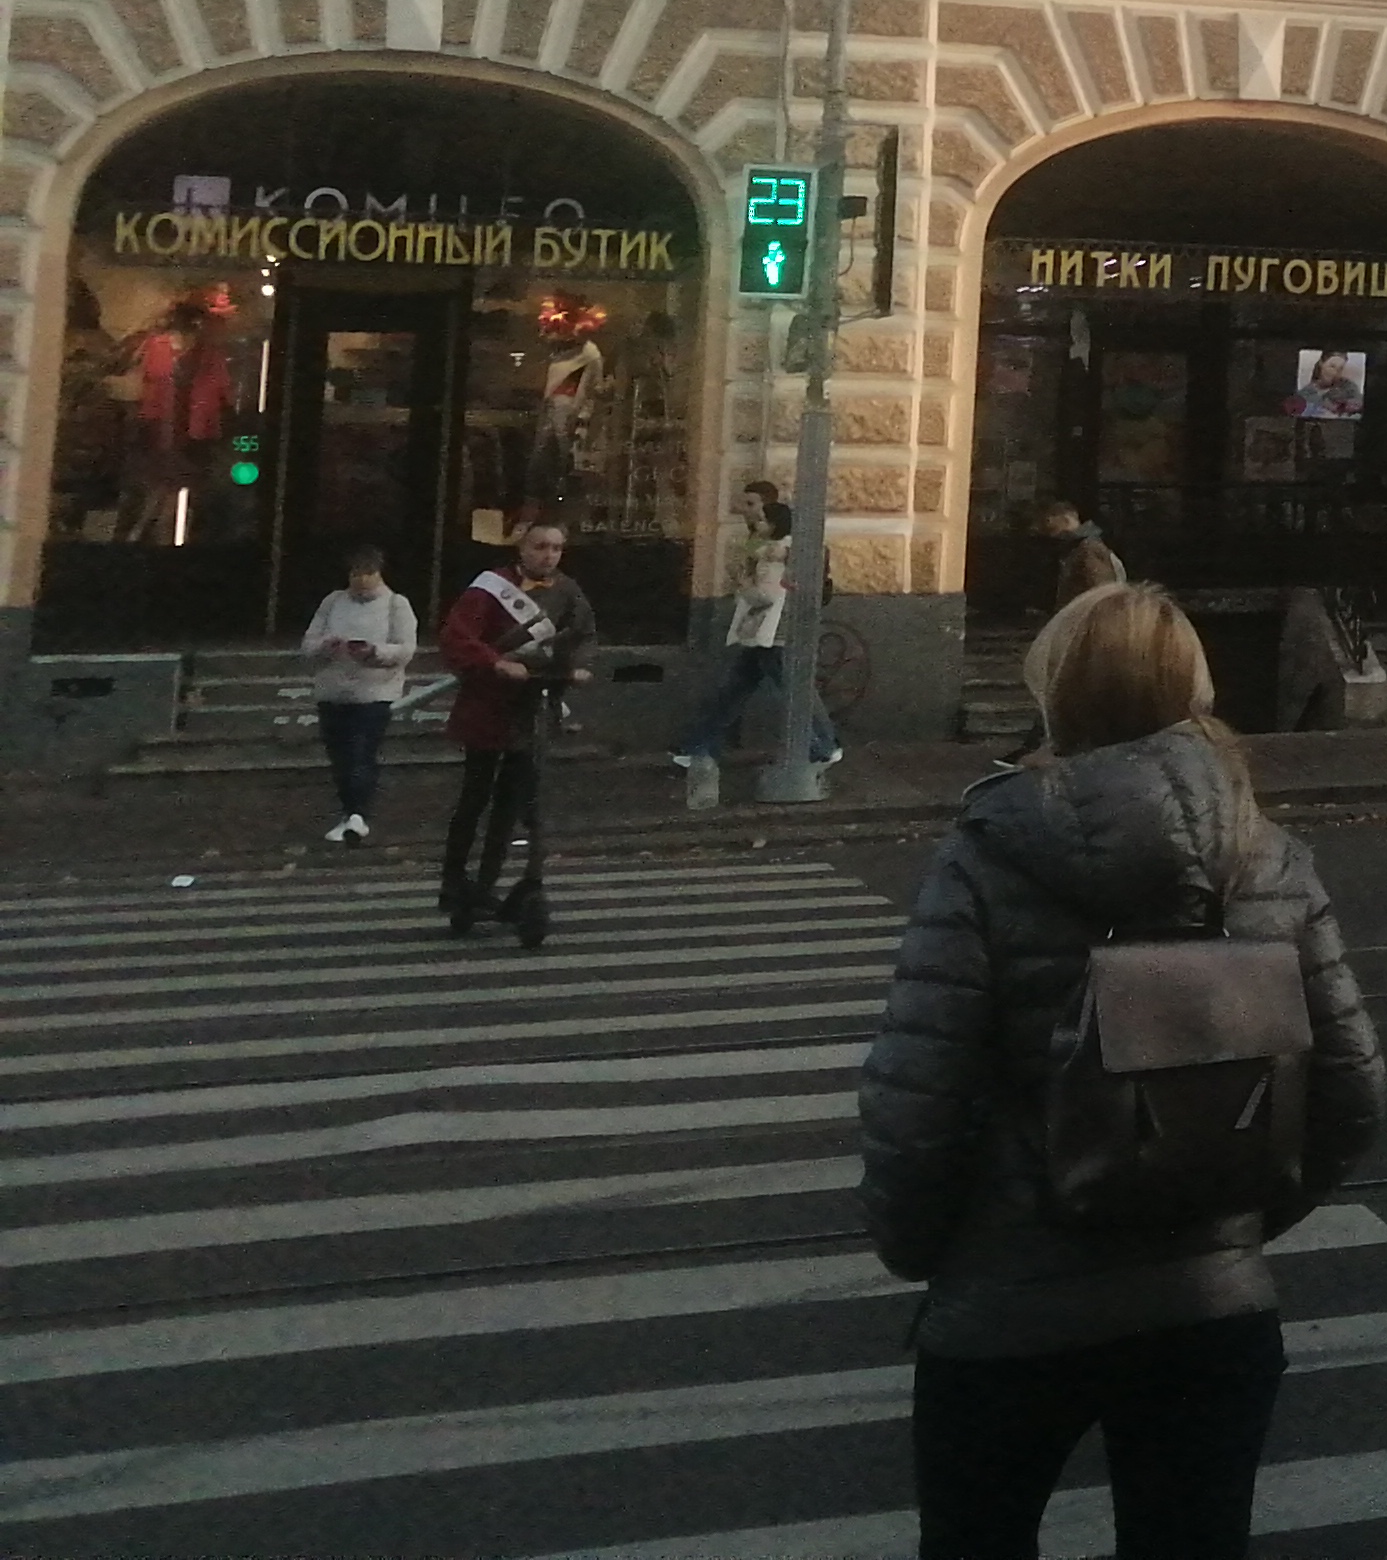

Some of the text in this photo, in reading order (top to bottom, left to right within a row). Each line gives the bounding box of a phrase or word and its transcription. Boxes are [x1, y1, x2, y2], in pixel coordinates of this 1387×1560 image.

[748, 176, 806, 226] 23
[532, 225, 674, 272] БУТИК
[1030, 249, 1172, 290] НИТКИ
